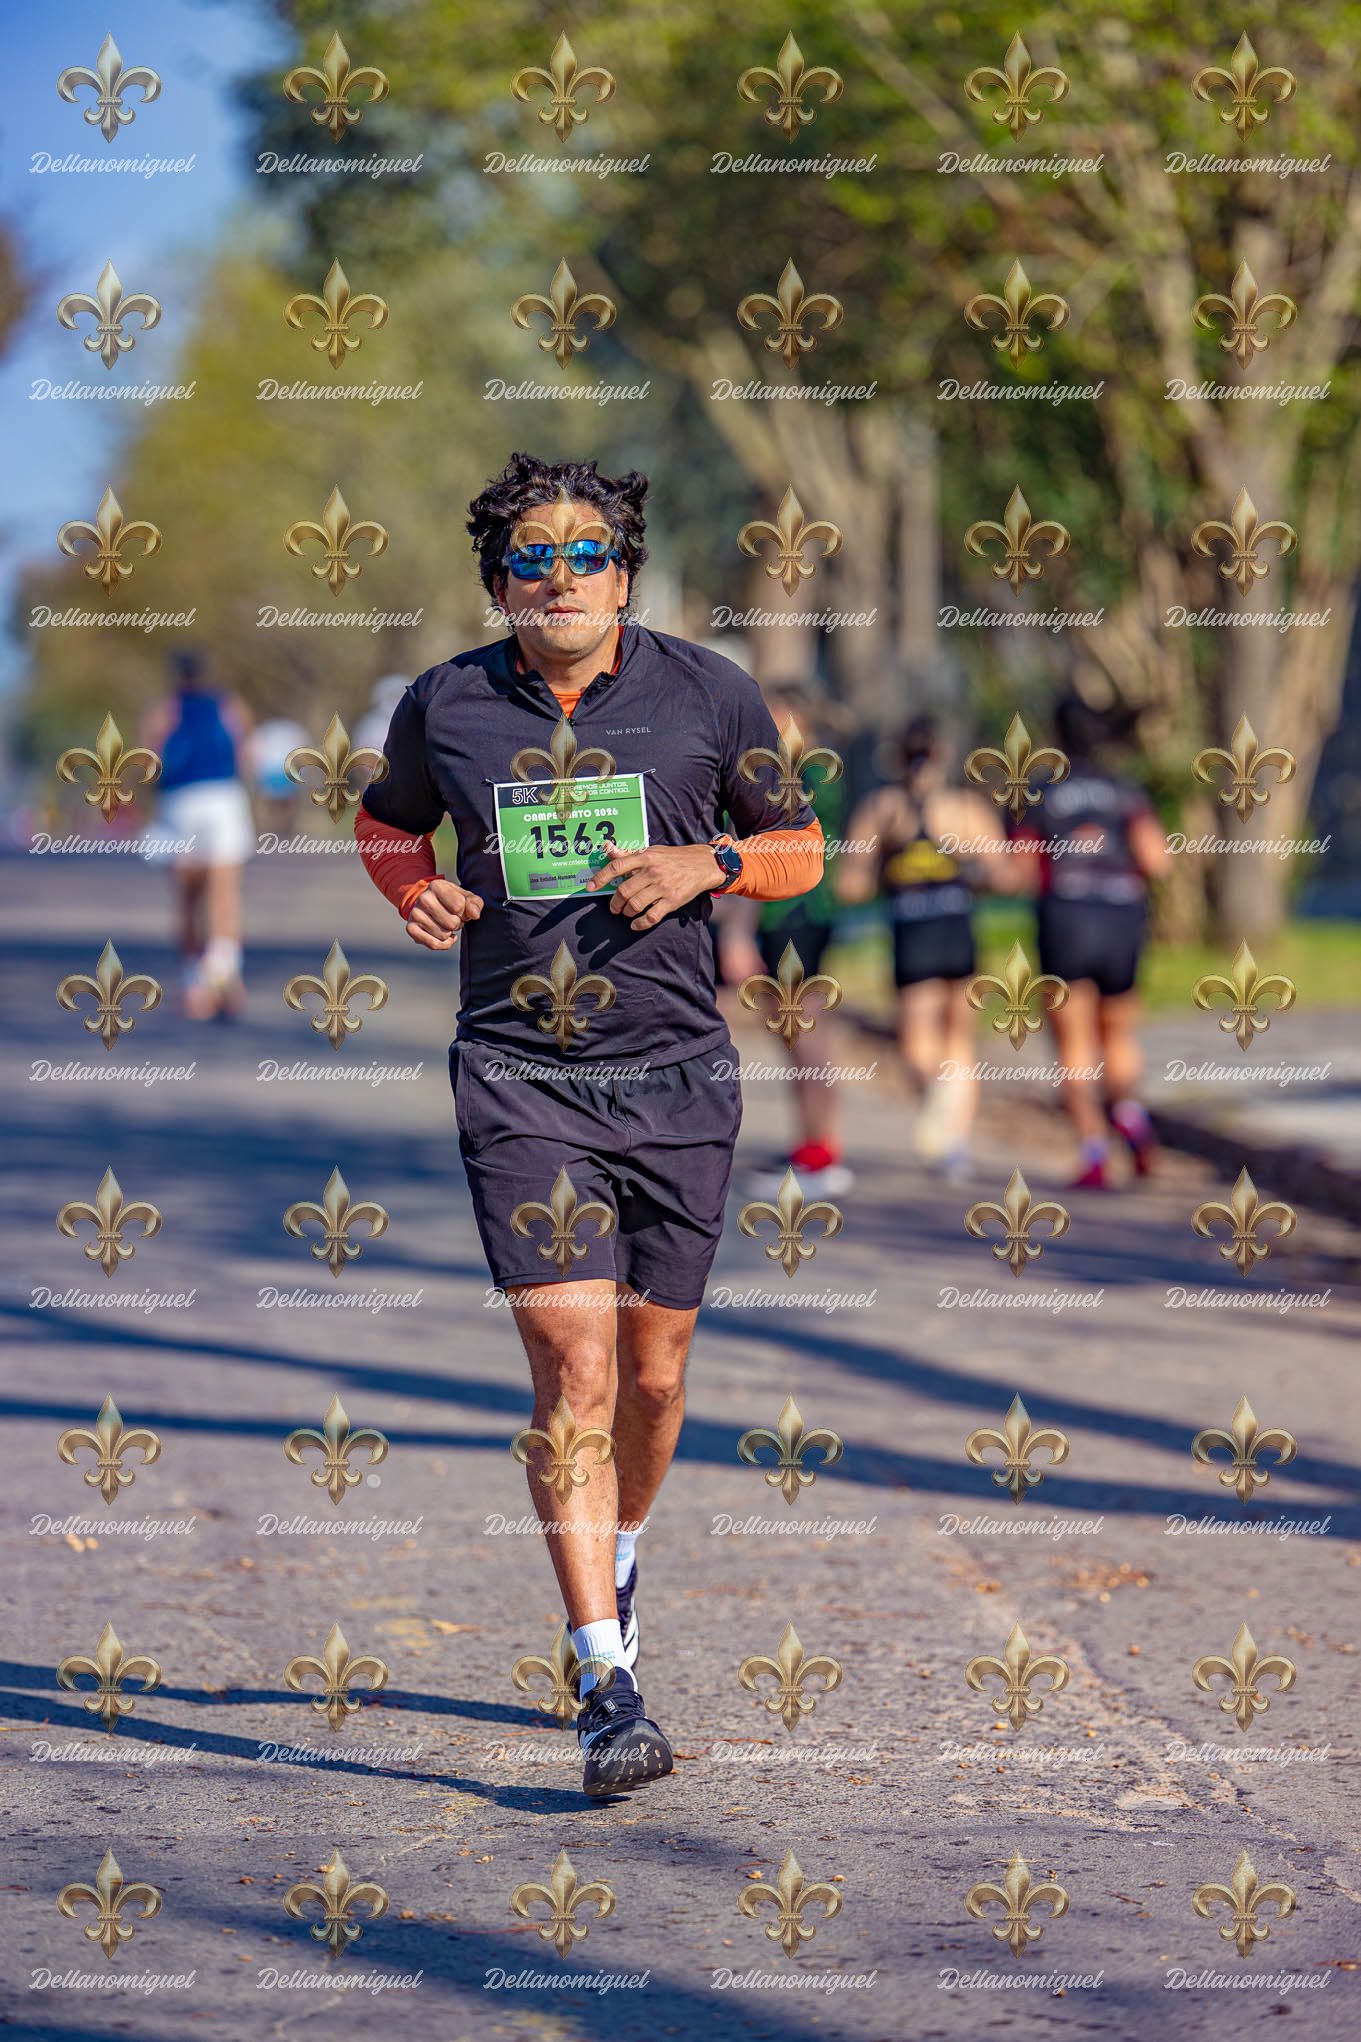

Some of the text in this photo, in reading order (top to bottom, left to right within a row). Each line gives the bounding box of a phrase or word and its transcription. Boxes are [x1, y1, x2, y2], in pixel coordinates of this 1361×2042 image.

[625, 726, 652, 734] RYSEL
[512, 787, 539, 805] 5K
[523, 807, 619, 822] CAMPEONATO 2026
[530, 820, 617, 859] 1563
